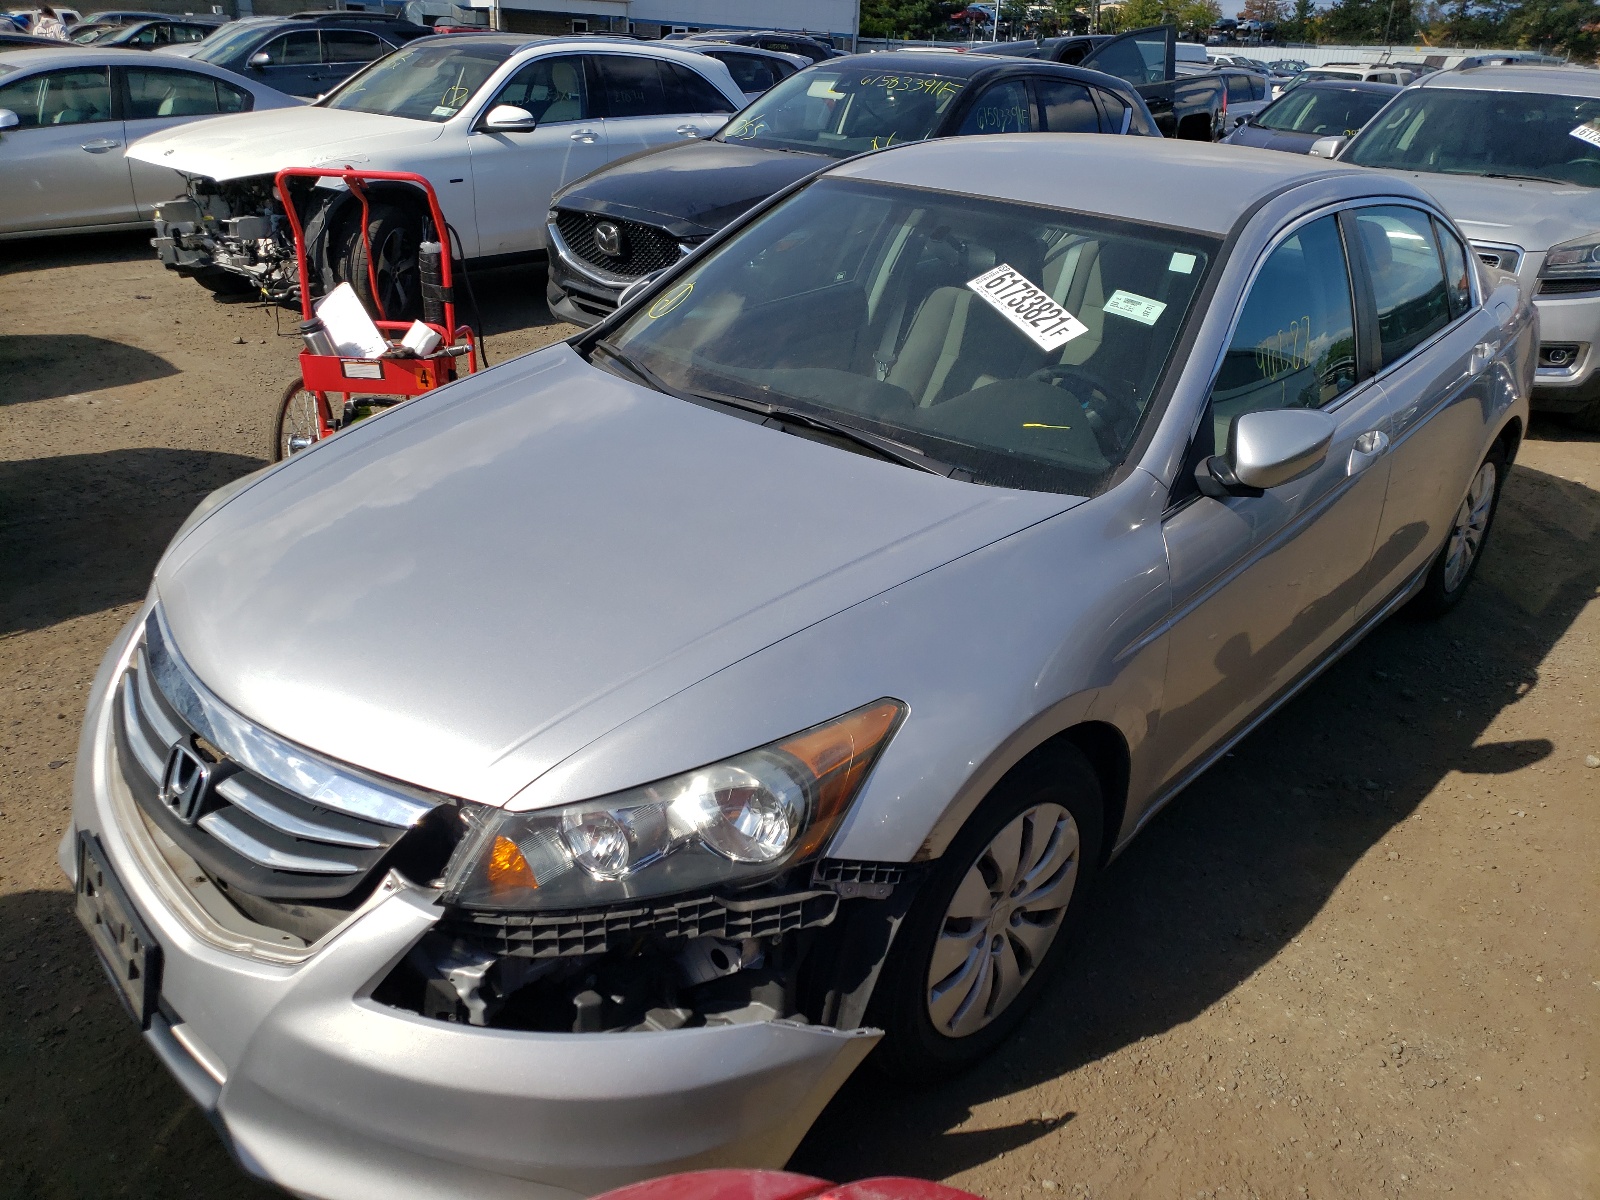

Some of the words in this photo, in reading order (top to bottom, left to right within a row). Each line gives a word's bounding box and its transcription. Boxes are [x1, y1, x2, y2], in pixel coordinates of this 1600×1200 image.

[860, 74, 964, 96] 61583391F
[985, 271, 1071, 337] 61733821F
[421, 370, 429, 387] 4
